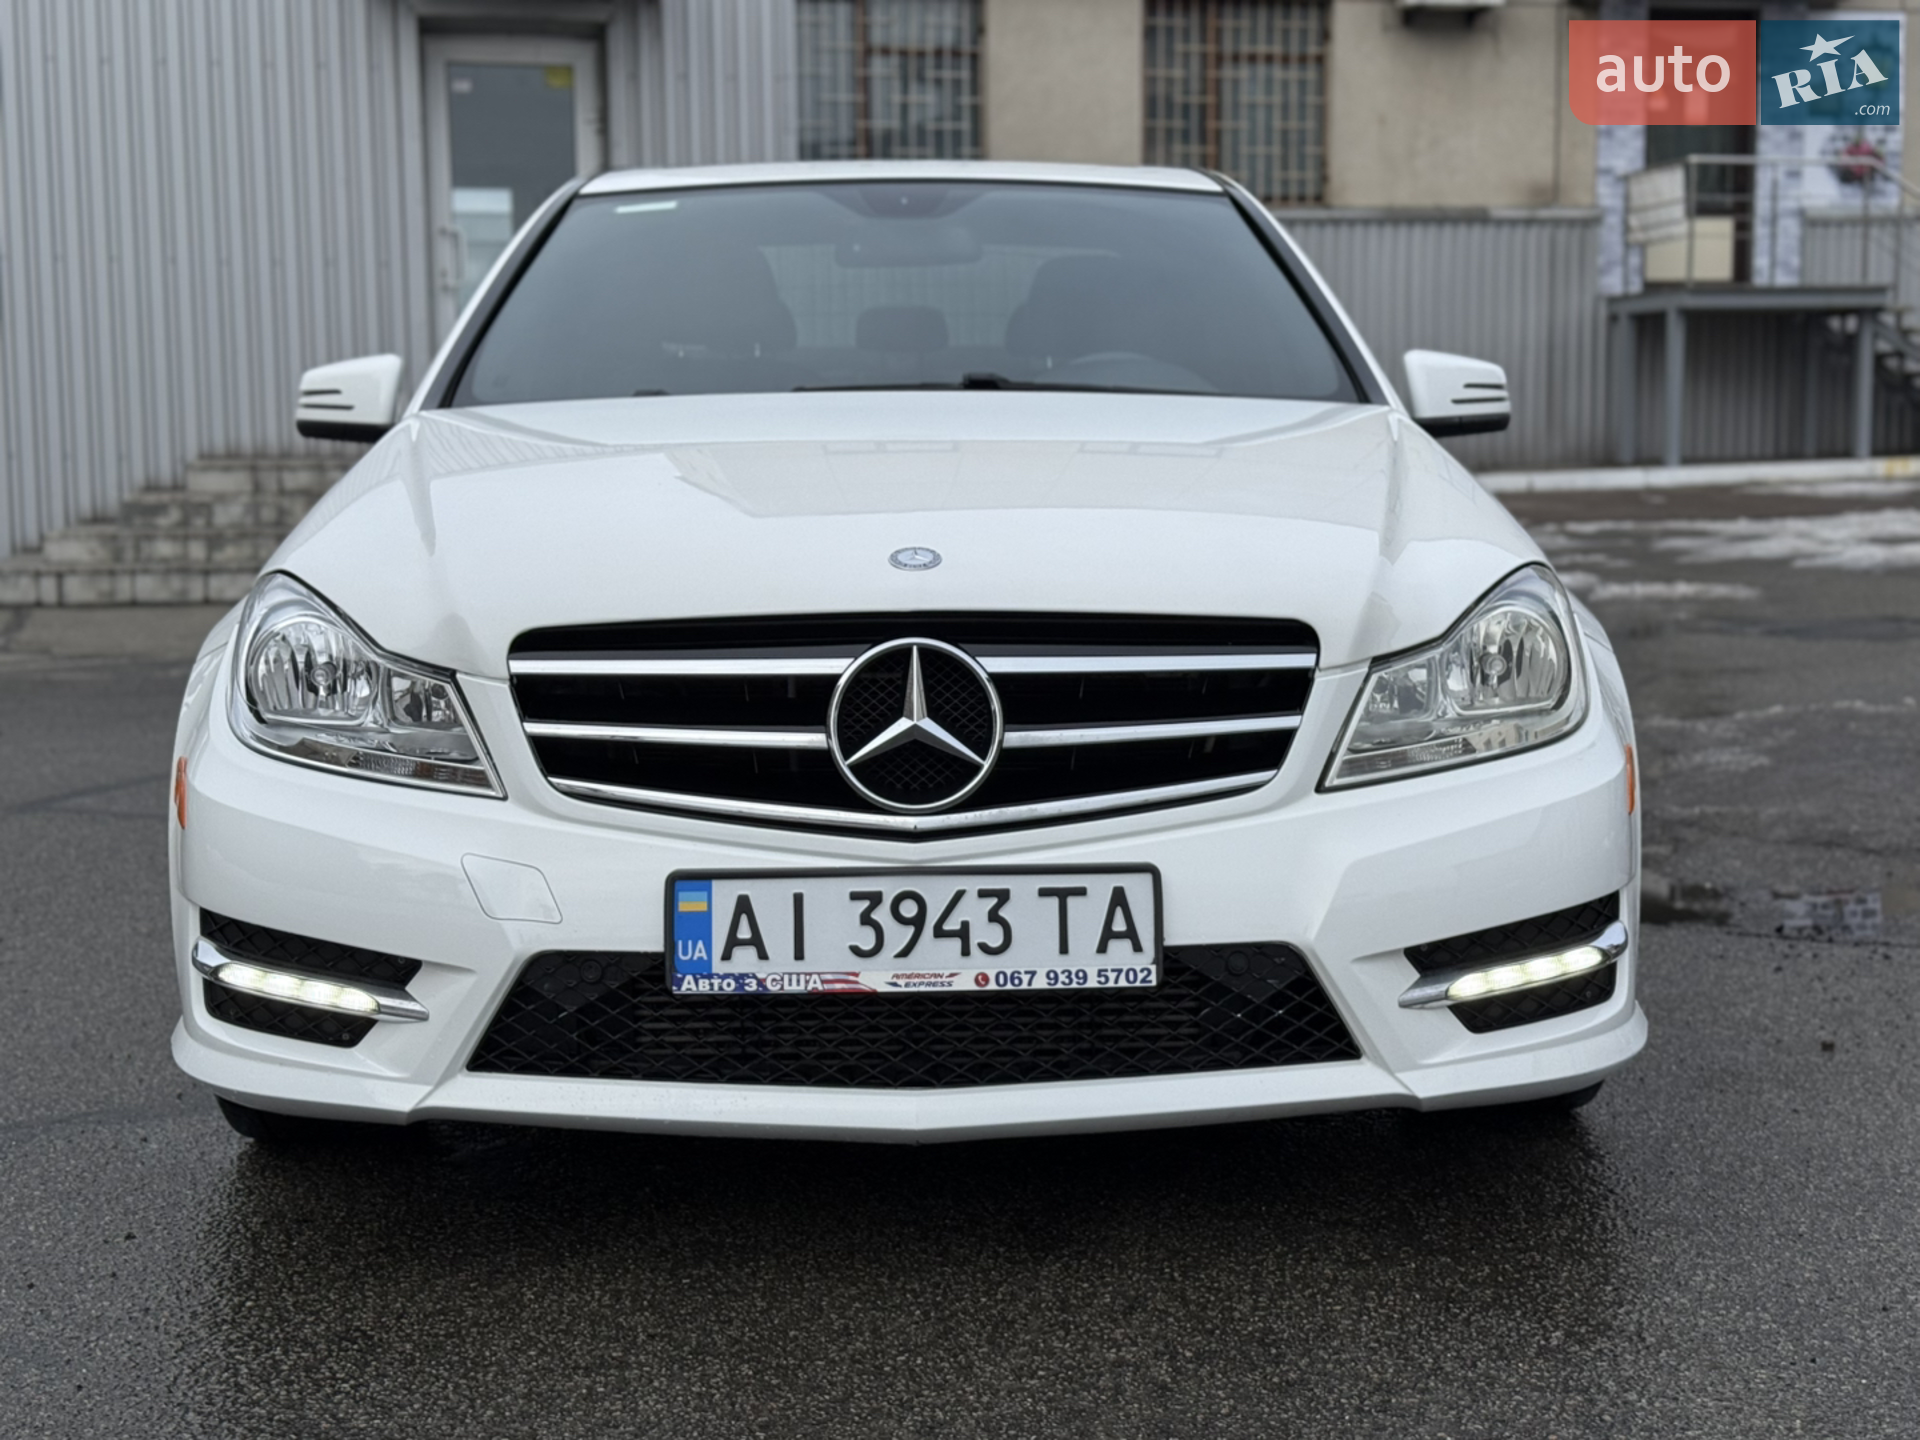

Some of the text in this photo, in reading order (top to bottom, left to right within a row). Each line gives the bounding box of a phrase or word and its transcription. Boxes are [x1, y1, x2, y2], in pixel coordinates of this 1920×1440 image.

[720, 885, 1144, 961] AI 3943 TA
[677, 940, 708, 961] UA
[680, 974, 736, 992] Авто
[765, 973, 825, 992] США
[904, 980, 954, 989] EXPRESS
[995, 967, 1153, 988] 067 939 5702
